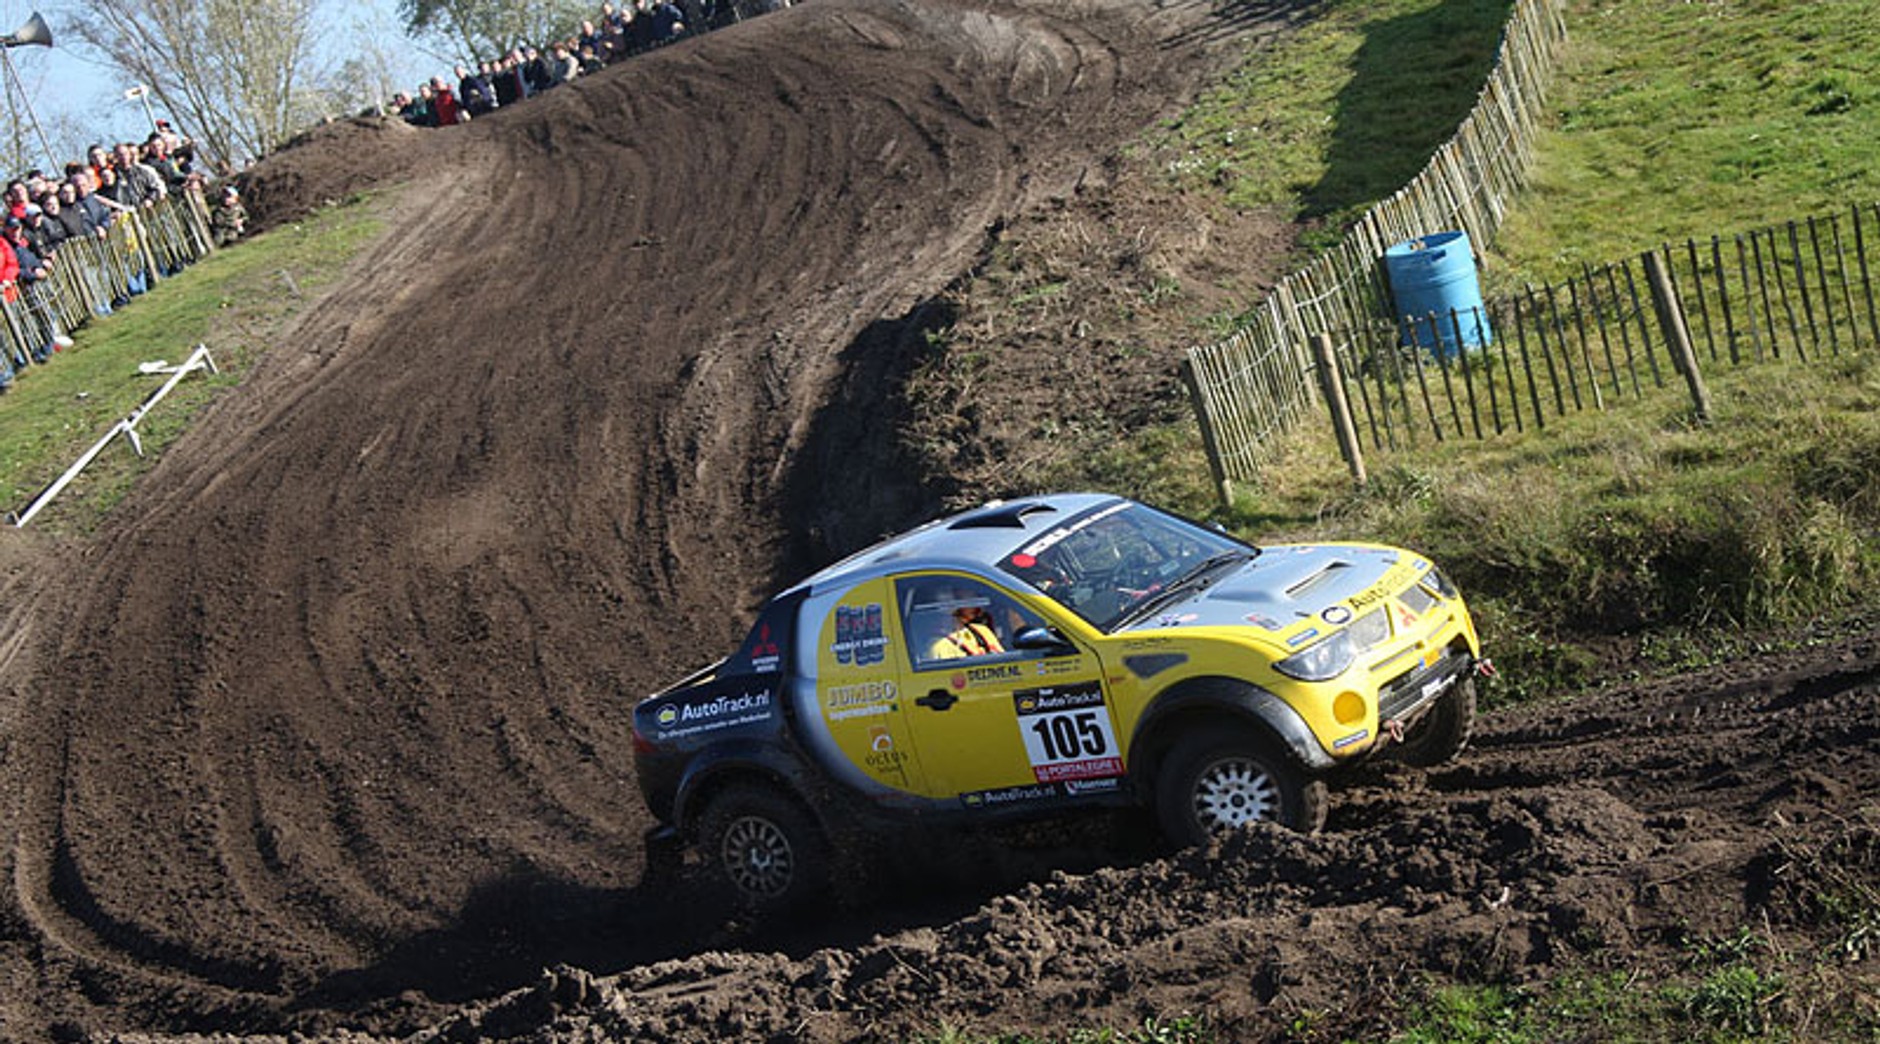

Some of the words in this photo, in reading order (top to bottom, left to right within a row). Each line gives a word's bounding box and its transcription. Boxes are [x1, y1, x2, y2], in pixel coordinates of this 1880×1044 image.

[681, 689, 770, 720] AutoTrack.nl
[828, 682, 897, 707] JUMBO
[1038, 690, 1101, 708] AutoTrack.nl
[1032, 713, 1106, 760] 105
[985, 784, 1056, 802] AutoTrack.nl
